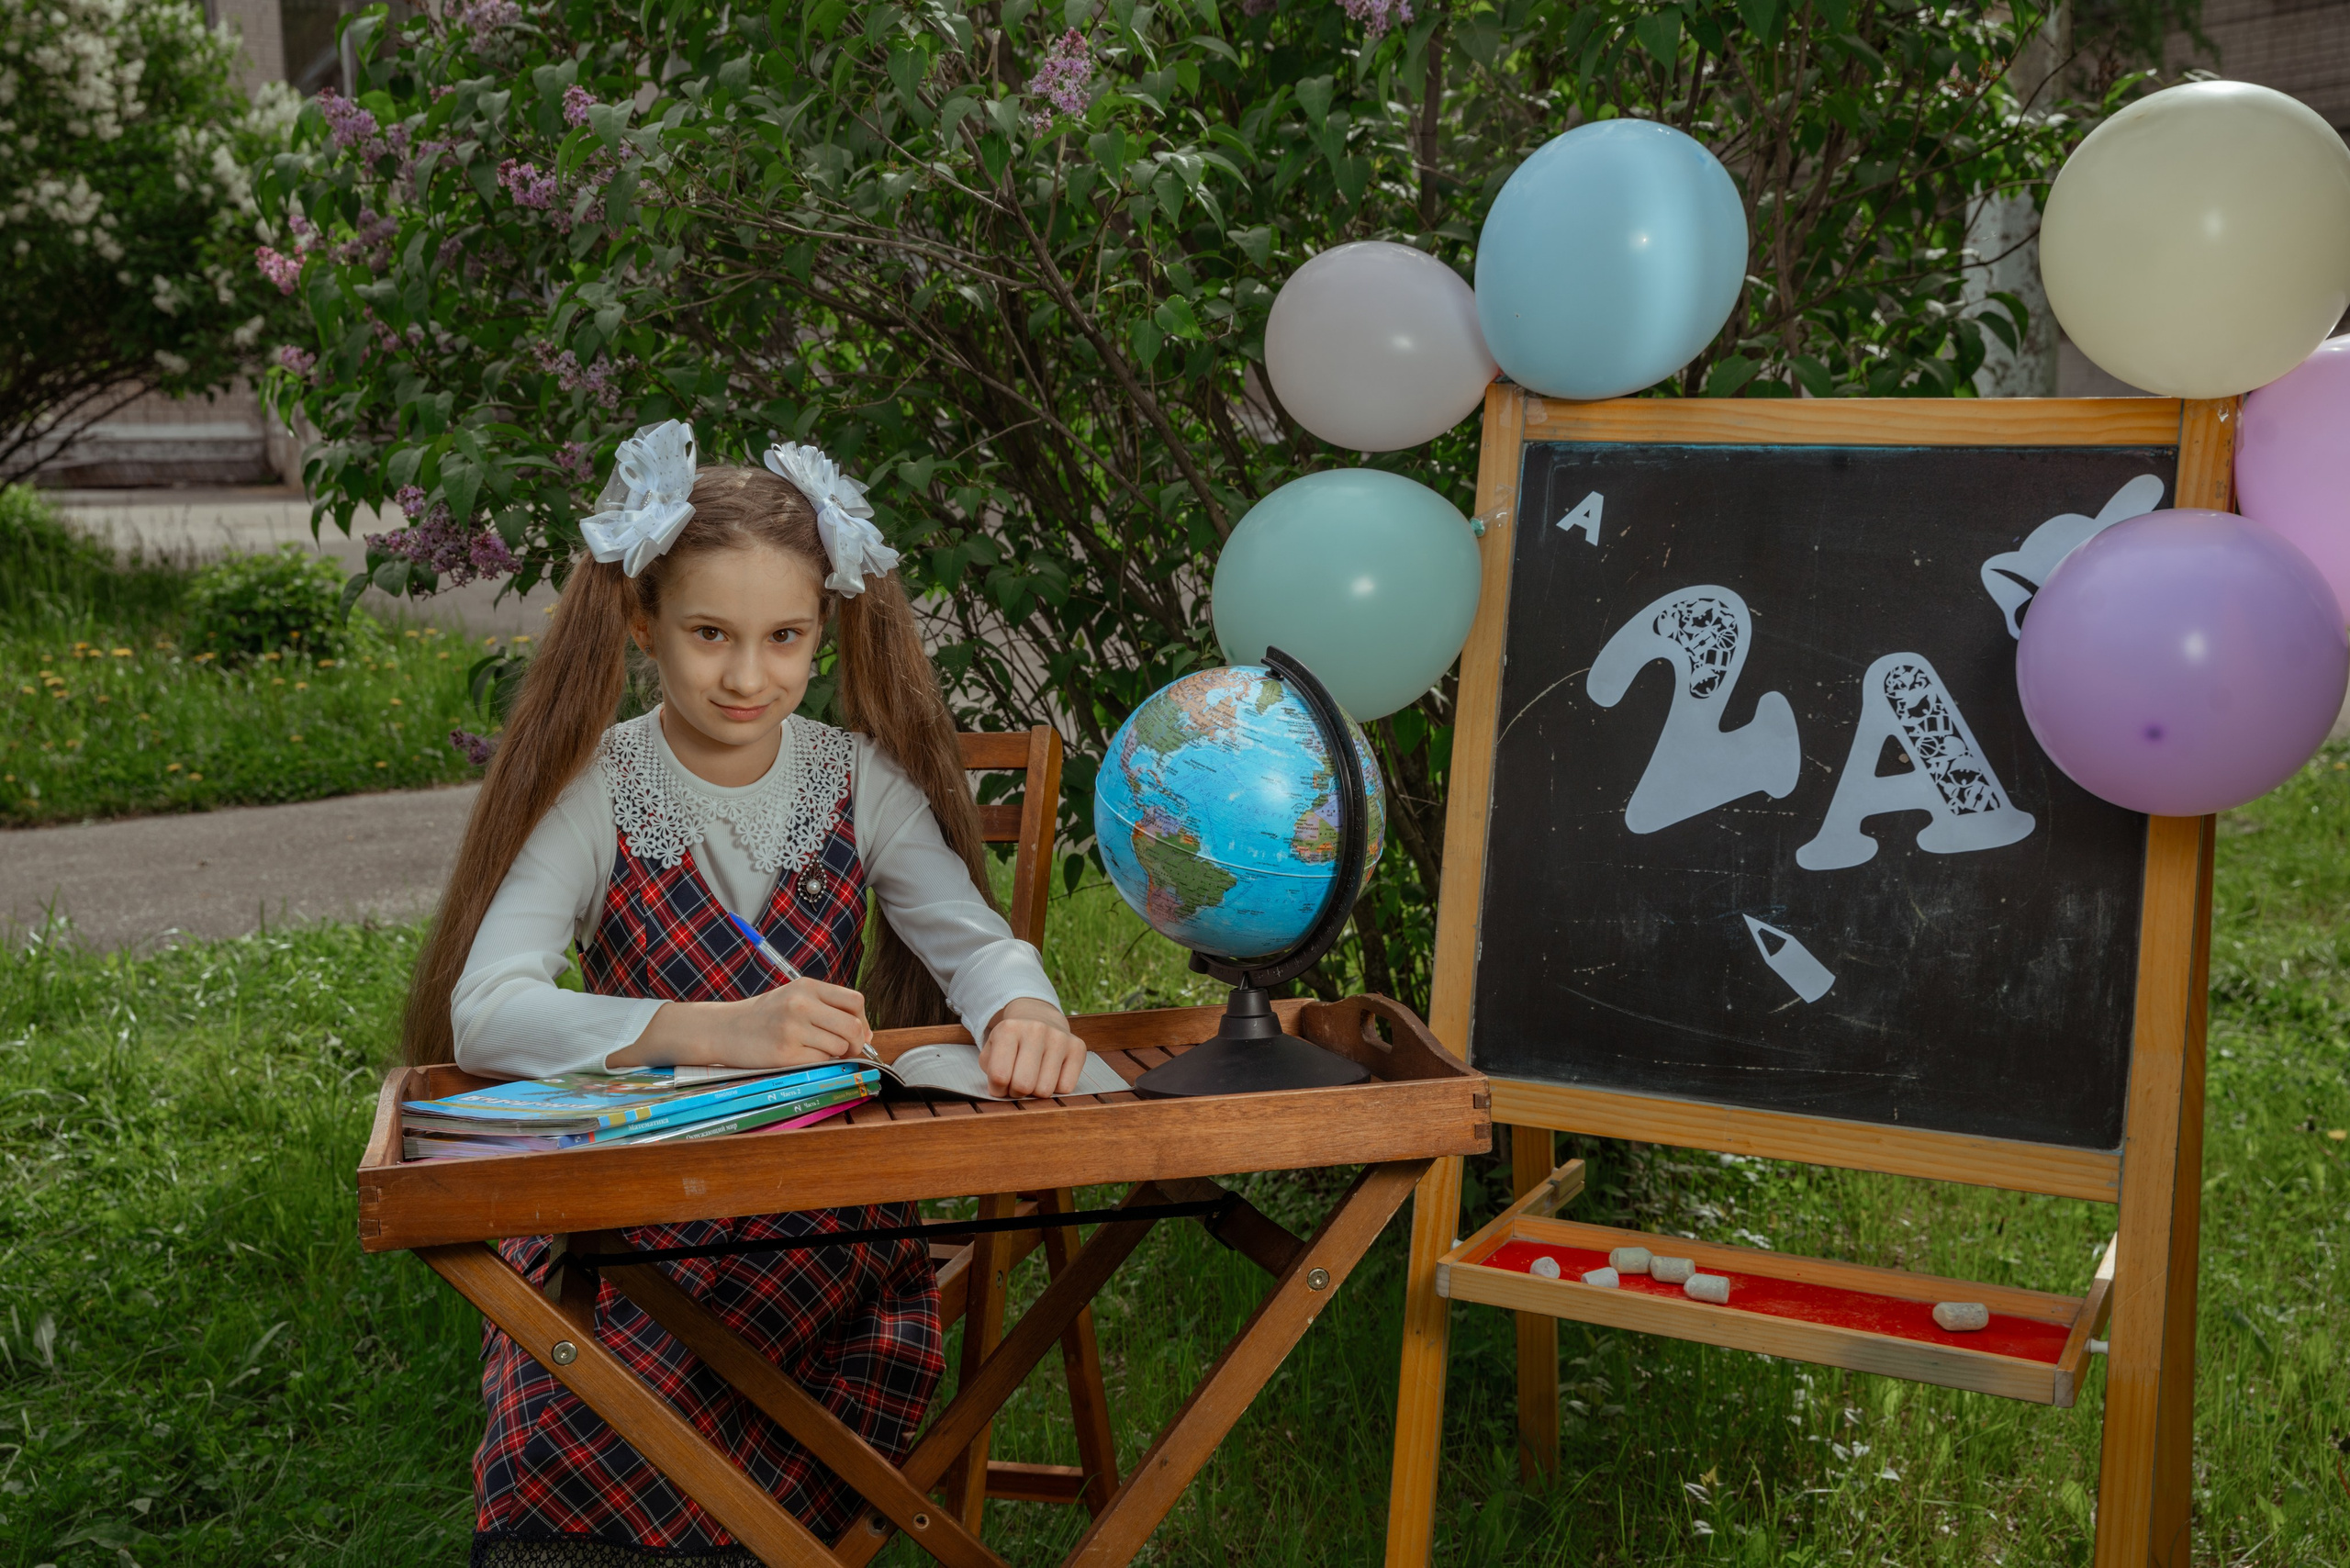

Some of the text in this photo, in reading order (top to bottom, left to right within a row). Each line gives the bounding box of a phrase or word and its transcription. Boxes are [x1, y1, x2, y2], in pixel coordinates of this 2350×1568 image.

[628, 1117, 669, 1131] Математика
[780, 1090, 797, 1098] Часть
[686, 1125, 725, 1140] Окружающий
[725, 1123, 738, 1132] мир
[804, 1101, 816, 1109] Часть
